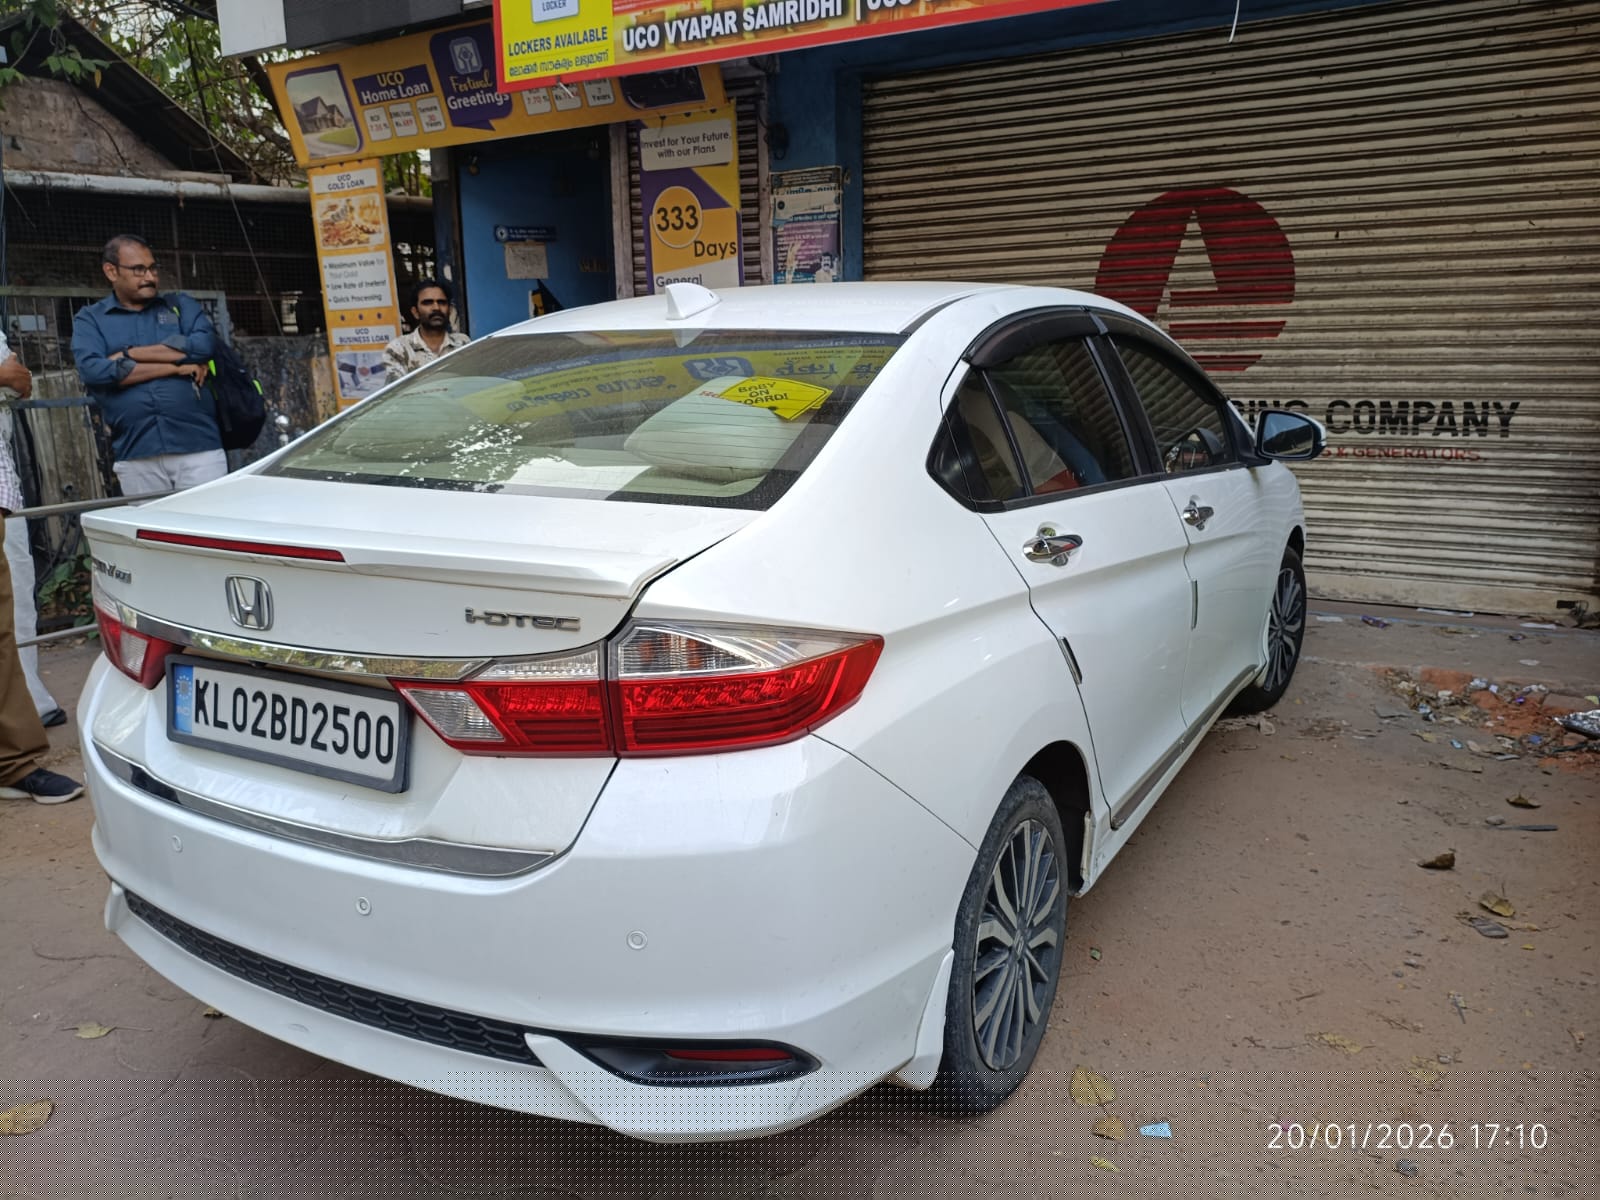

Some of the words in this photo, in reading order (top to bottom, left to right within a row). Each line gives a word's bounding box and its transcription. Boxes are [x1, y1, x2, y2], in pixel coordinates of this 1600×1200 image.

[542, 0, 567, 11] LOCKER
[622, 24, 660, 52] UCO
[664, 10, 738, 44] VYAPAR
[742, 0, 843, 32] SAMRIDHI
[508, 37, 552, 56] LOCKERS
[554, 26, 608, 49] AVAILABLE
[376, 72, 405, 87] UCO
[361, 88, 398, 105] Home
[398, 82, 429, 99] Loan
[447, 90, 510, 110] Greetings
[680, 133, 700, 145] Your
[657, 148, 675, 159] with
[676, 148, 691, 157] our
[693, 144, 717, 155] Plans
[327, 182, 345, 191] GOLD
[346, 179, 365, 189] LOAN
[337, 174, 352, 182] UCO
[656, 204, 699, 232] 333
[694, 240, 737, 260] Days
[339, 336, 371, 344] BUSINESS
[371, 334, 390, 342] LOAN
[738, 382, 777, 393] BABY
[749, 389, 770, 398] ON
[737, 393, 789, 405] OARD!
[1325, 400, 1520, 438] COMPANY
[194, 679, 395, 764] KL02BD2500
